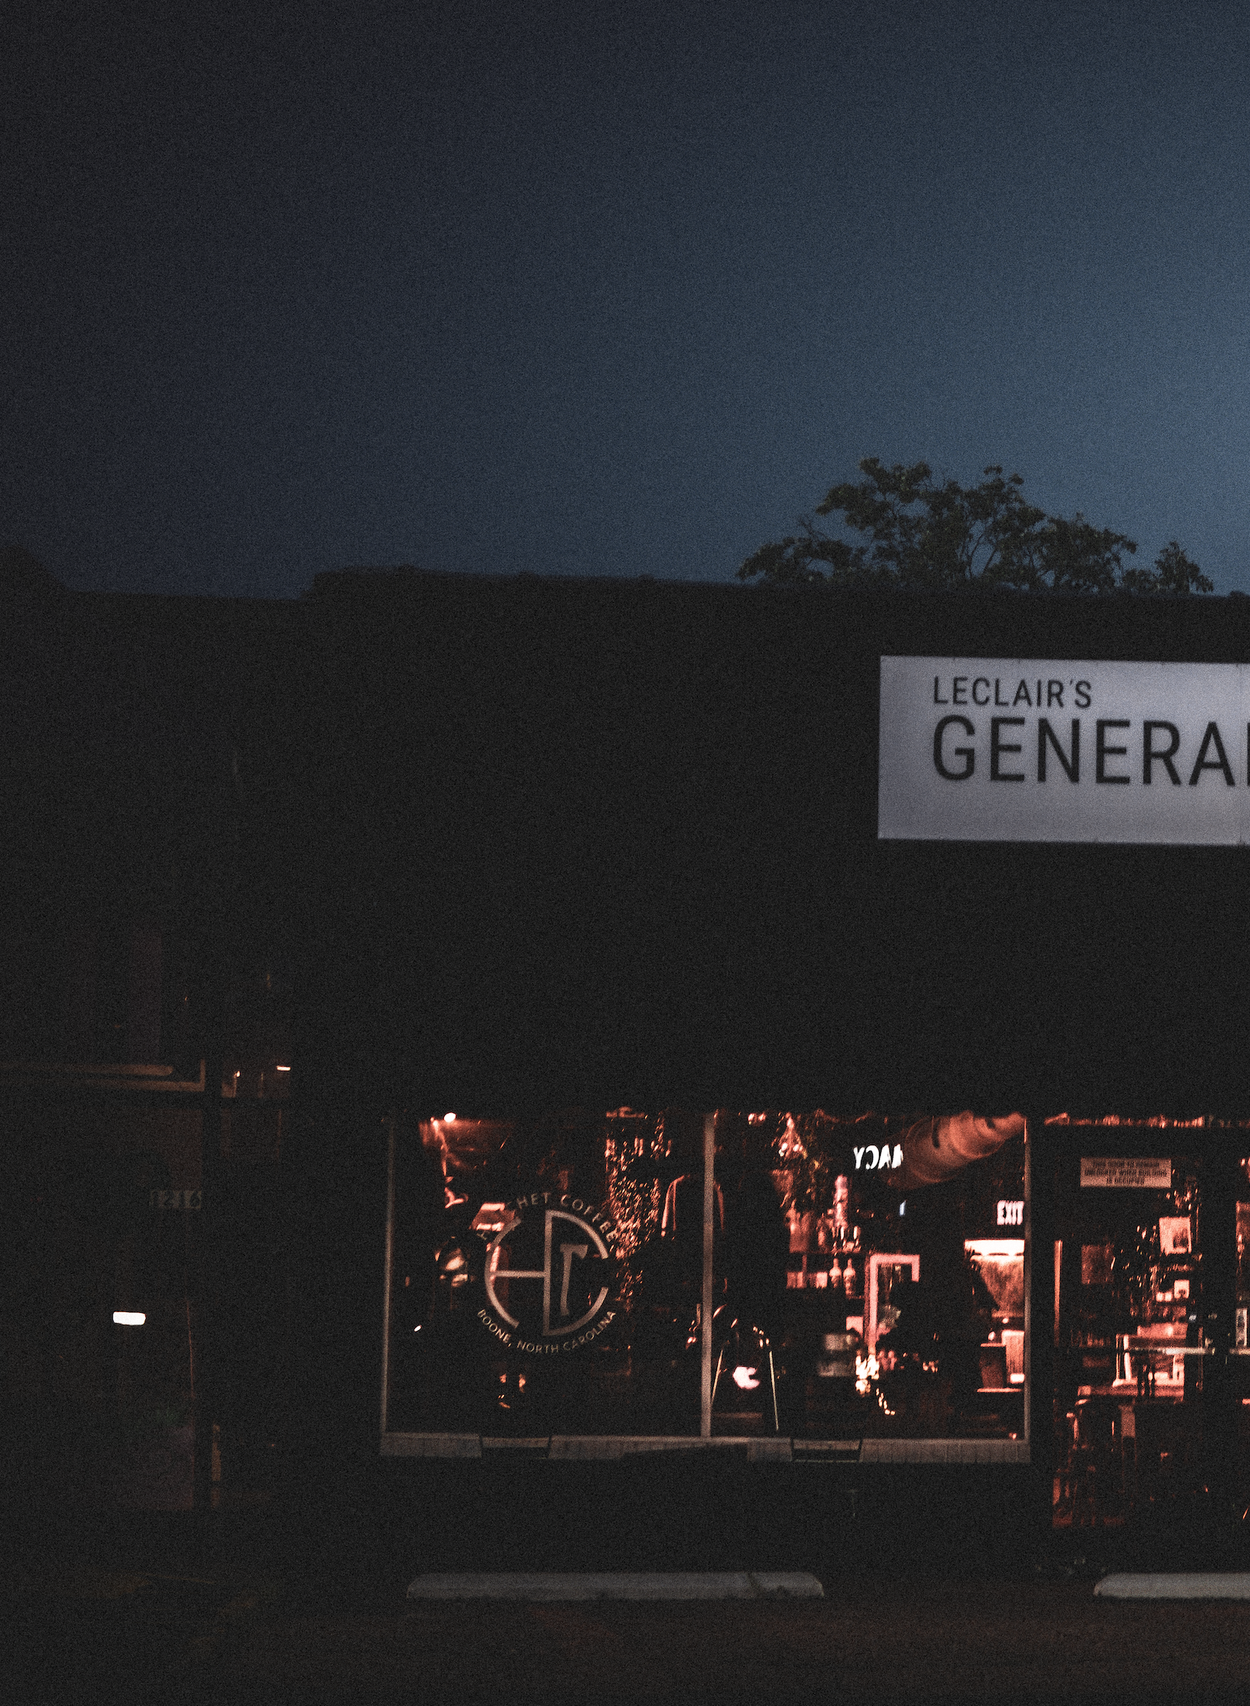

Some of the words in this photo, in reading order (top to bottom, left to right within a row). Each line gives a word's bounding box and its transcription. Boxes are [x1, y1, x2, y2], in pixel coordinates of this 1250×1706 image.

[933, 676, 1092, 709] LECLAIR'S
[996, 1200, 1025, 1226] EXIT
[516, 1339, 559, 1355] NORTH
[562, 1309, 617, 1352] CAROLINA
